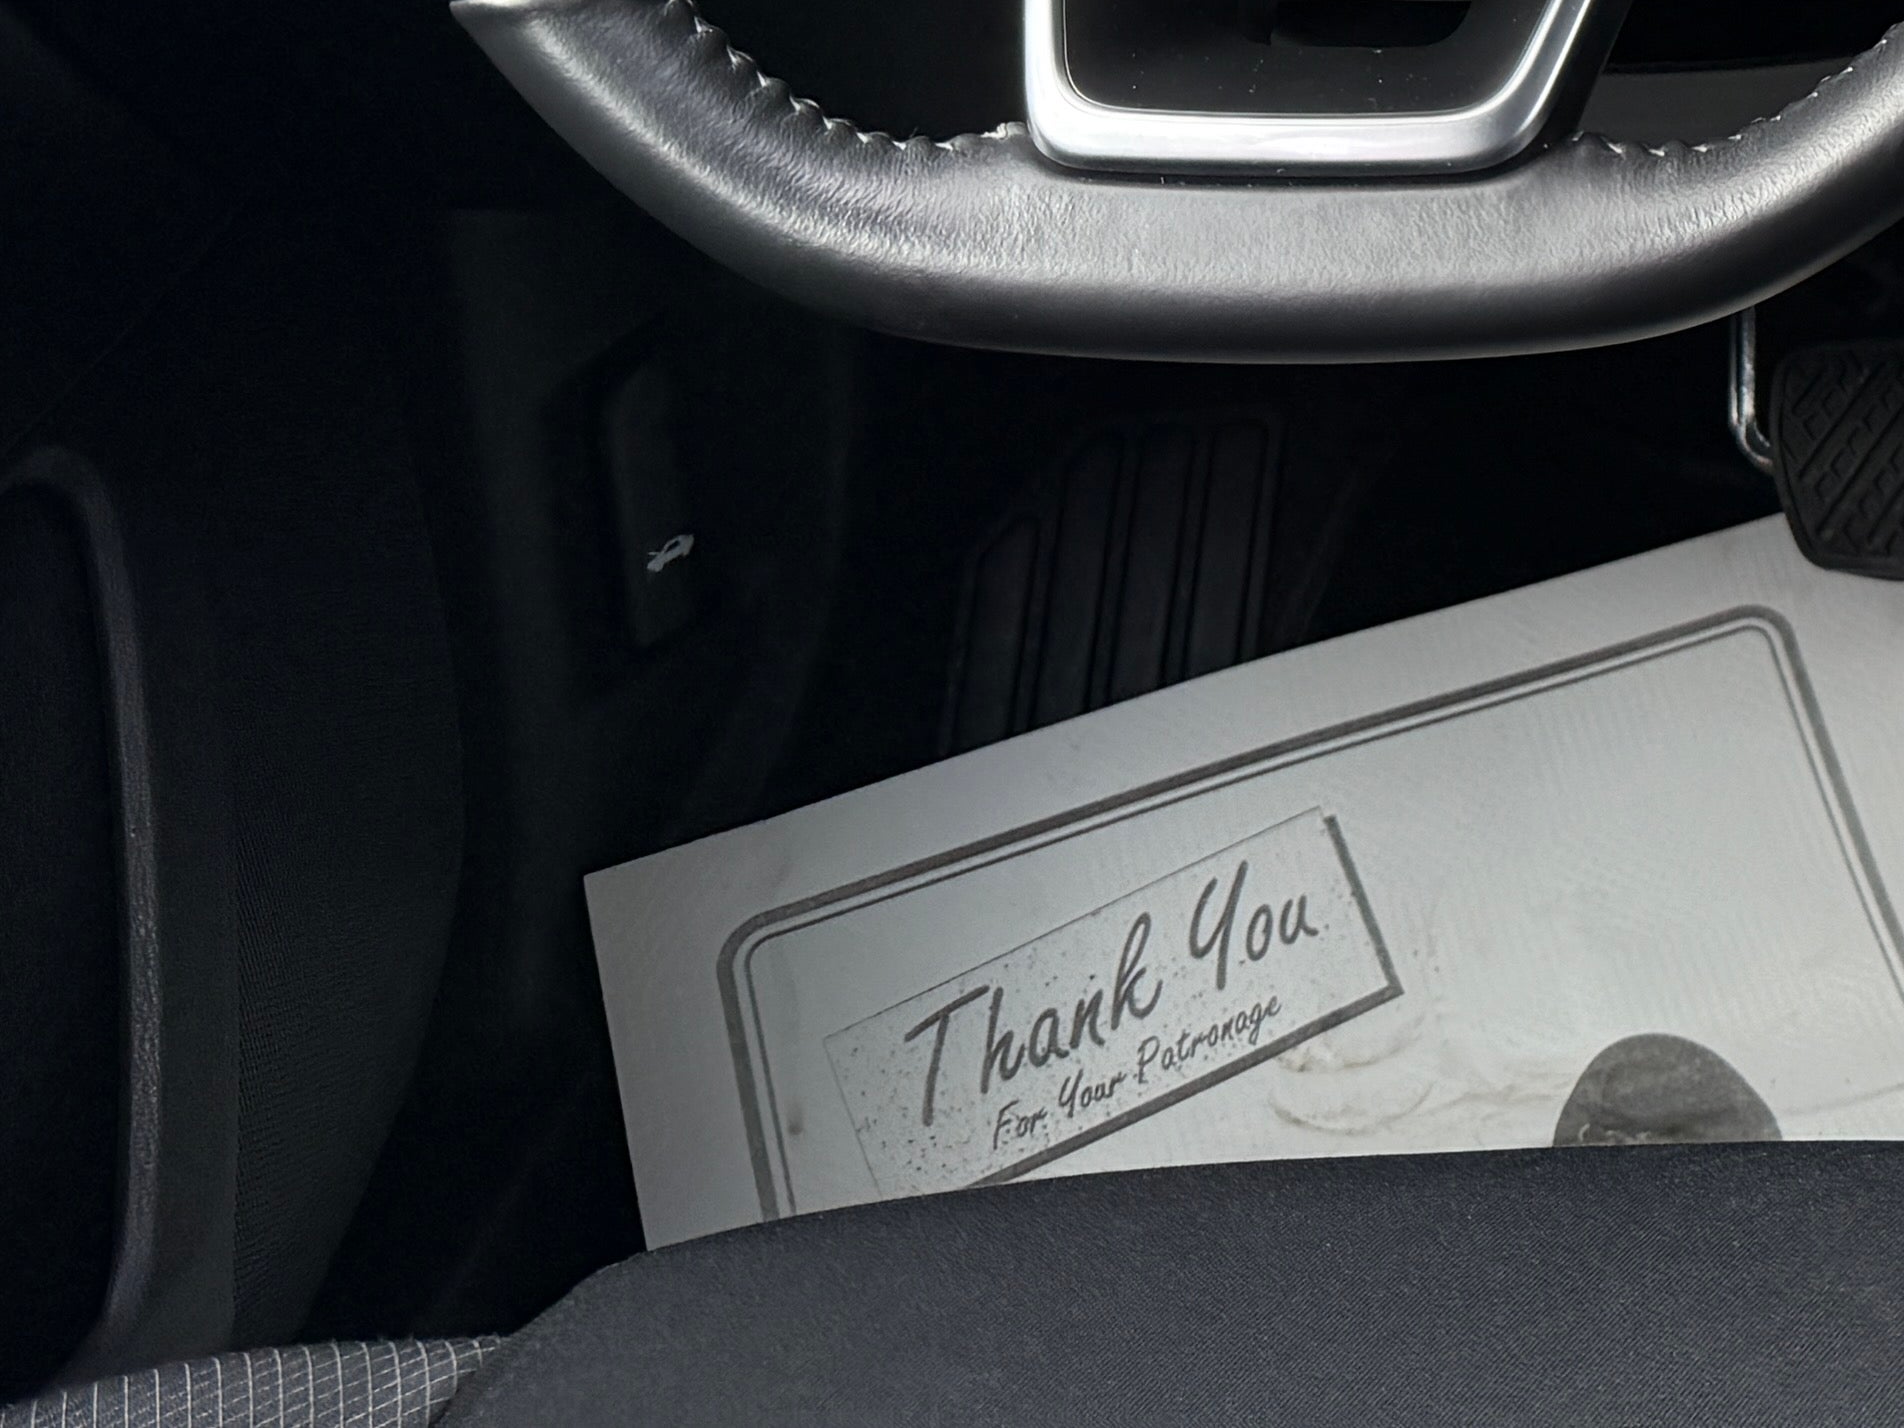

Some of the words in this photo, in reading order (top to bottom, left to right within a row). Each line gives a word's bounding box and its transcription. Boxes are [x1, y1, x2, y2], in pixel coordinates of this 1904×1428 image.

[904, 912, 1163, 1126] Thank
[1189, 860, 1319, 990] You
[993, 1099, 1049, 1150] For
[1058, 1071, 1126, 1114] Your
[1132, 992, 1282, 1084] Patronage
